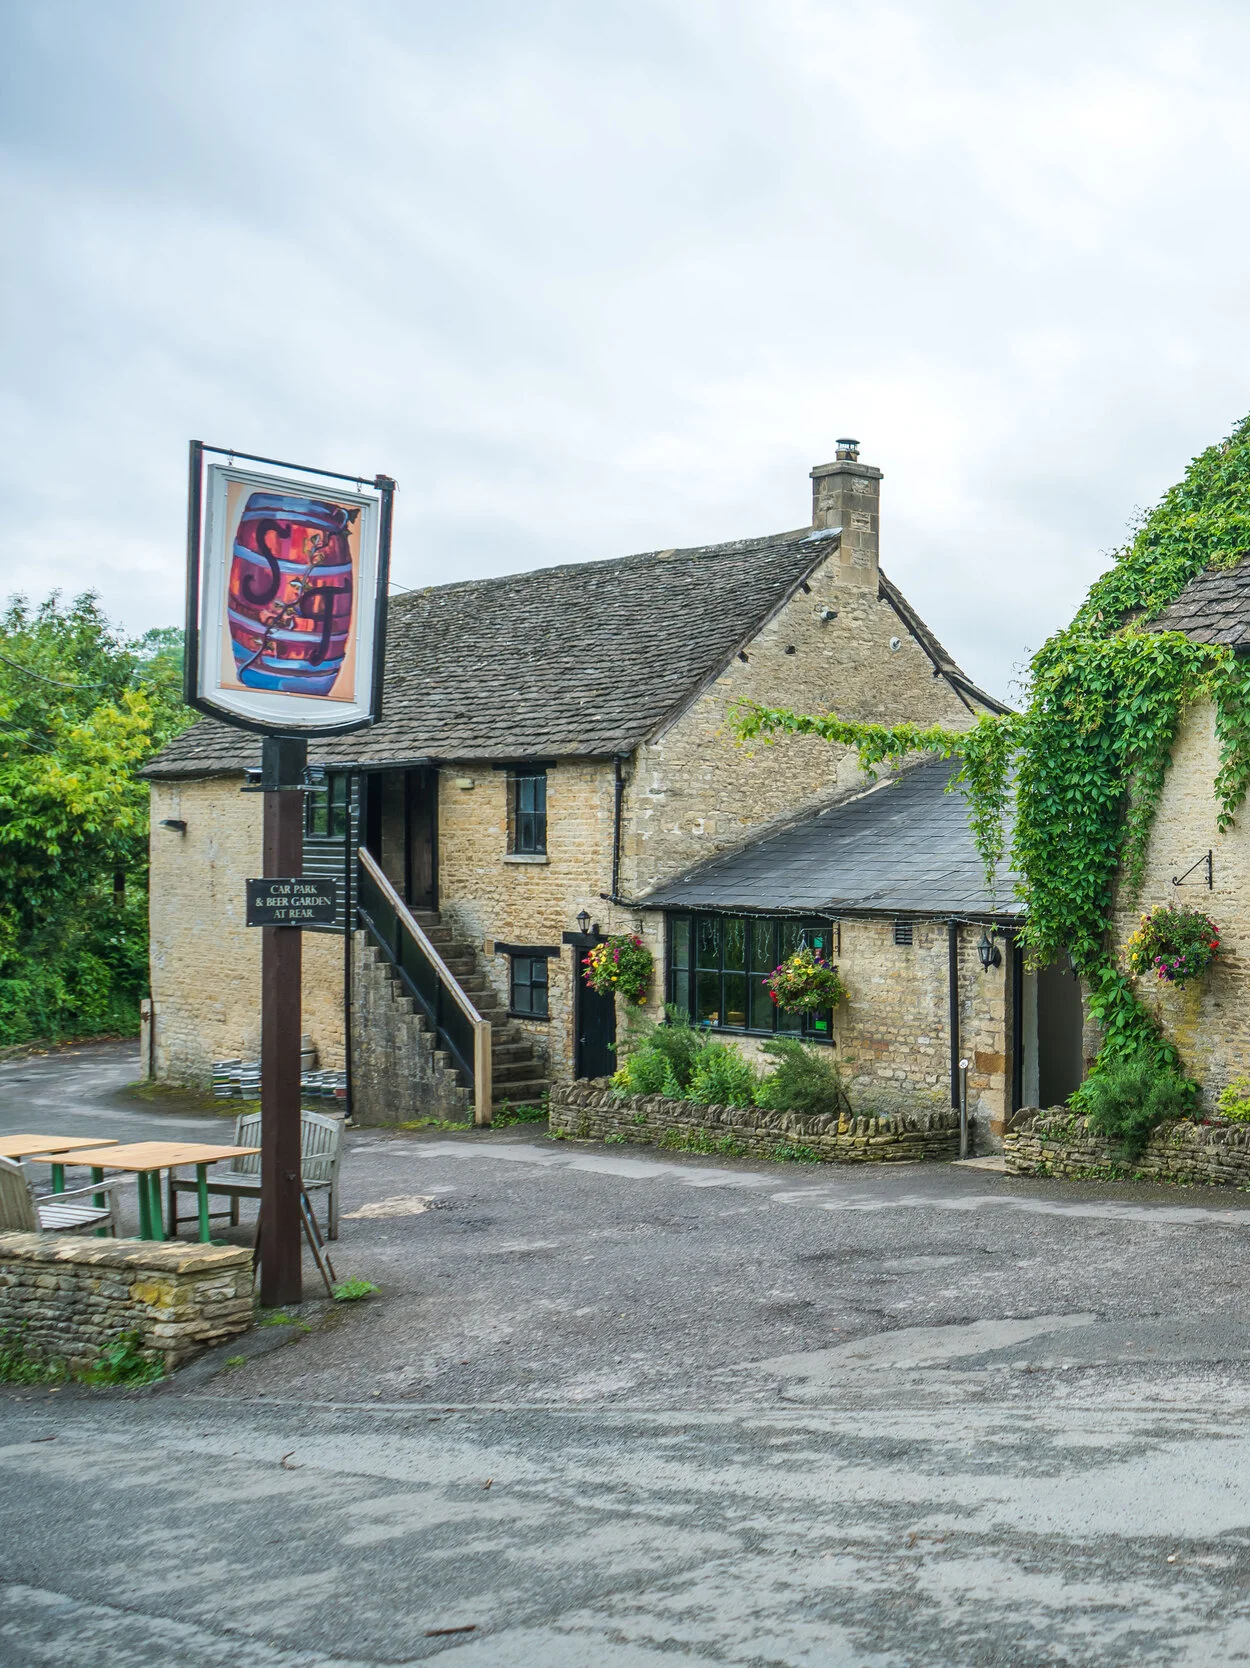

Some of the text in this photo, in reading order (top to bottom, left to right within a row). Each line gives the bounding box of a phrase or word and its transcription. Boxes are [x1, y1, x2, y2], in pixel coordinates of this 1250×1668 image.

[270, 884, 318, 894] CAR PARK
[255, 896, 332, 907] & BEER GARDEN
[273, 909, 316, 918] AT REAR
